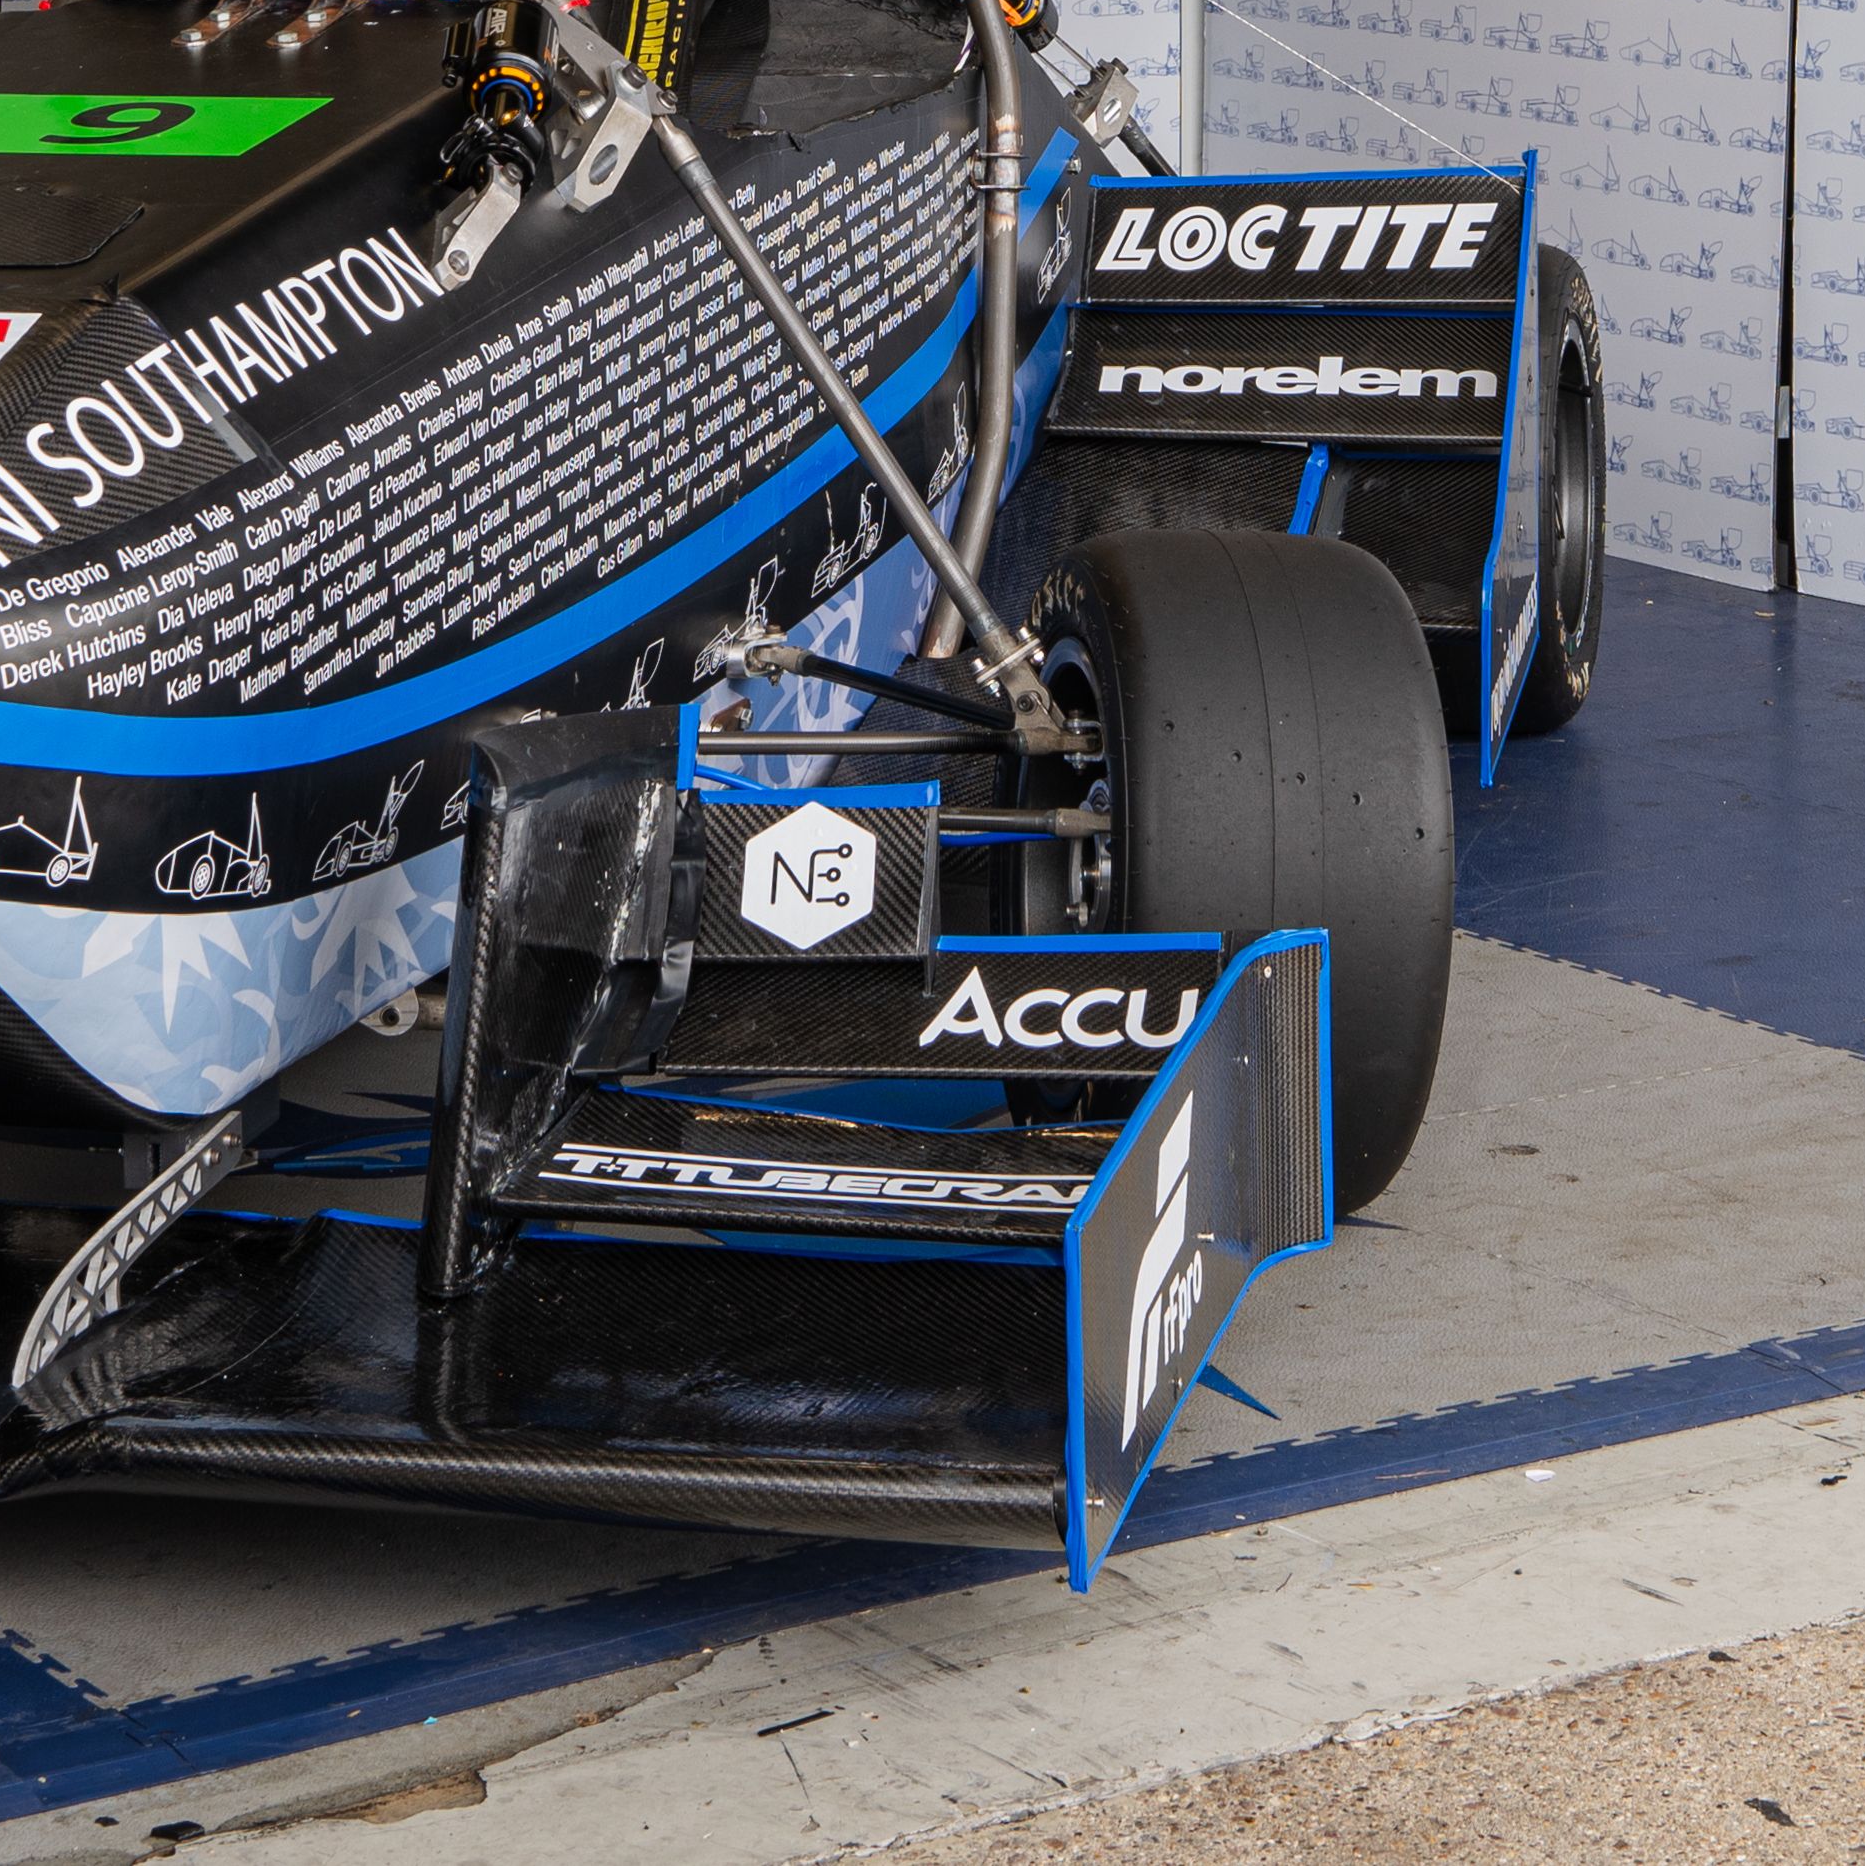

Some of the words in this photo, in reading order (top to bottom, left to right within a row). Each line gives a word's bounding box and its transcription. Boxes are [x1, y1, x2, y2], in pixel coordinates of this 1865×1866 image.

[39, 102, 196, 145] 9
[26, 228, 443, 508] SOUTHAMPTON
[1098, 356, 1497, 398] norelem
[0, 616, 52, 649] Bliss
[65, 584, 150, 629] Capucine
[153, 543, 238, 598] Leroy-Smith
[245, 520, 283, 550] Carlo
[326, 461, 370, 501] Caroline
[374, 433, 412, 471] Annetts
[418, 409, 455, 442] Charles
[456, 388, 483, 418] Haley
[26, 561, 110, 601] Gregorio
[116, 523, 197, 573] Alexander
[195, 503, 235, 533] Vale
[289, 439, 344, 480] Williams
[345, 402, 403, 448] Alexandra
[404, 380, 441, 413] Brewis
[516, 317, 544, 344] Anne
[542, 295, 573, 326] Smith
[1, 652, 63, 690] Derek
[68, 622, 146, 667] Hutchins
[158, 606, 185, 634] Dia
[185, 582, 235, 620] Veleva
[243, 558, 280, 592] Diego
[319, 519, 335, 541] De
[336, 502, 362, 532] Luca
[369, 488, 384, 510] Ed
[385, 456, 427, 500] Peacock
[434, 430, 470, 466] Edward
[469, 416, 489, 446] Van
[491, 393, 529, 430] Oostrum
[88, 656, 148, 699] Hayley
[150, 634, 203, 675] Brooks
[215, 608, 252, 645] Henry
[254, 585, 294, 622] Rigden
[320, 535, 365, 577] Goodwin
[372, 509, 402, 542] Jakub
[403, 480, 442, 520] Kuchnio
[449, 460, 480, 490] James
[484, 434, 515, 467] Draper
[166, 672, 202, 705] Kate
[208, 643, 252, 686] Draper
[261, 625, 289, 654] Keira
[291, 603, 315, 637] Byre
[322, 587, 344, 611] Kris
[345, 559, 377, 594] Collier
[385, 528, 429, 569] Laurence
[431, 501, 456, 532] Read
[463, 484, 491, 514] Lukas
[493, 447, 541, 492] Hindmarch
[240, 659, 286, 704] Matthew
[291, 621, 339, 670] Banfather
[346, 586, 389, 630] Matthew
[394, 546, 446, 596] Trowbridge
[304, 649, 352, 695] Samantha
[354, 616, 395, 661] Loveday
[403, 580, 446, 624] Sandeep
[376, 651, 394, 678] Jim
[395, 621, 435, 663] Rabbets
[442, 597, 472, 630] Laurie
[472, 572, 501, 607] Dwyer
[472, 614, 496, 641] Ross
[1164, 1250, 1202, 1365] rFpro
